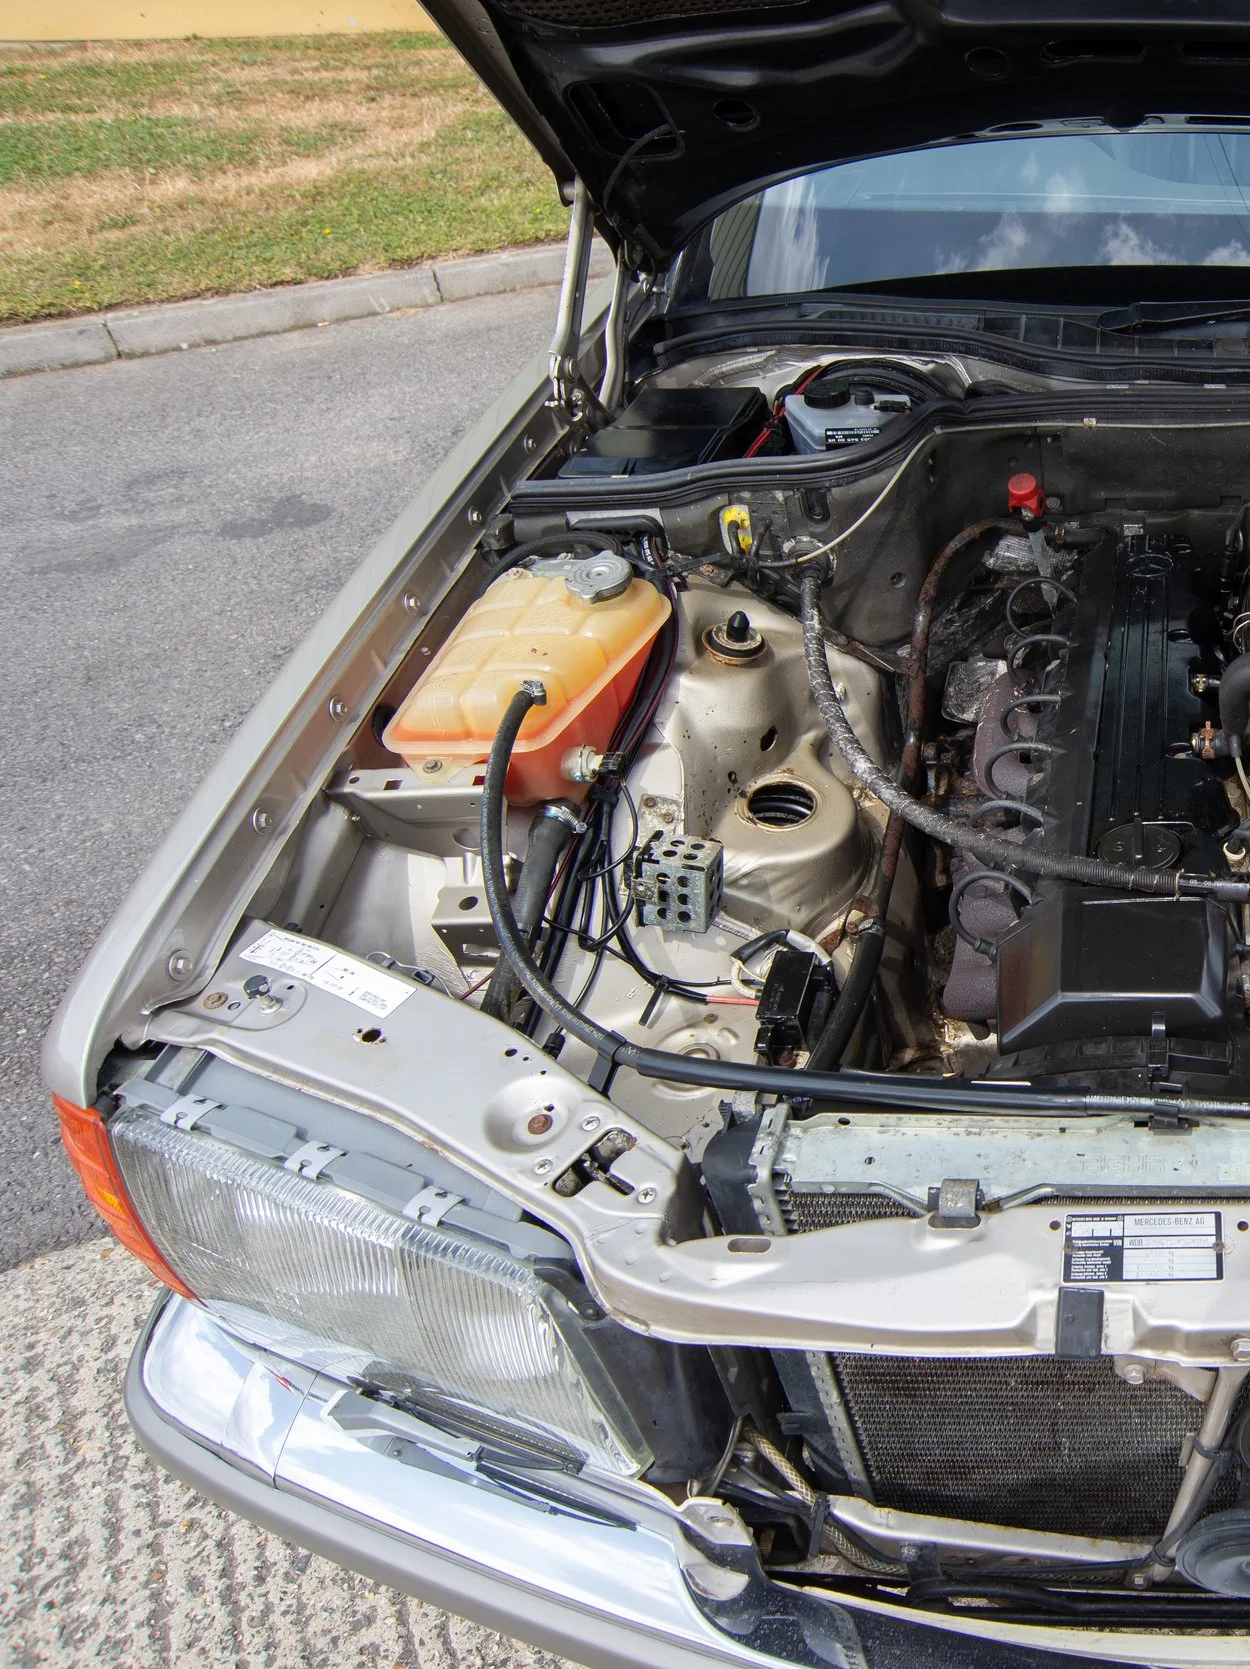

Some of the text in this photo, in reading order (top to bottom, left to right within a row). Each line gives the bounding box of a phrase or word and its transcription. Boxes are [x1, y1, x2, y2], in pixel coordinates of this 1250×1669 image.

[1134, 1217, 1205, 1226] MERCEDES-BENZ AG
[1128, 1238, 1144, 1246] WDB
